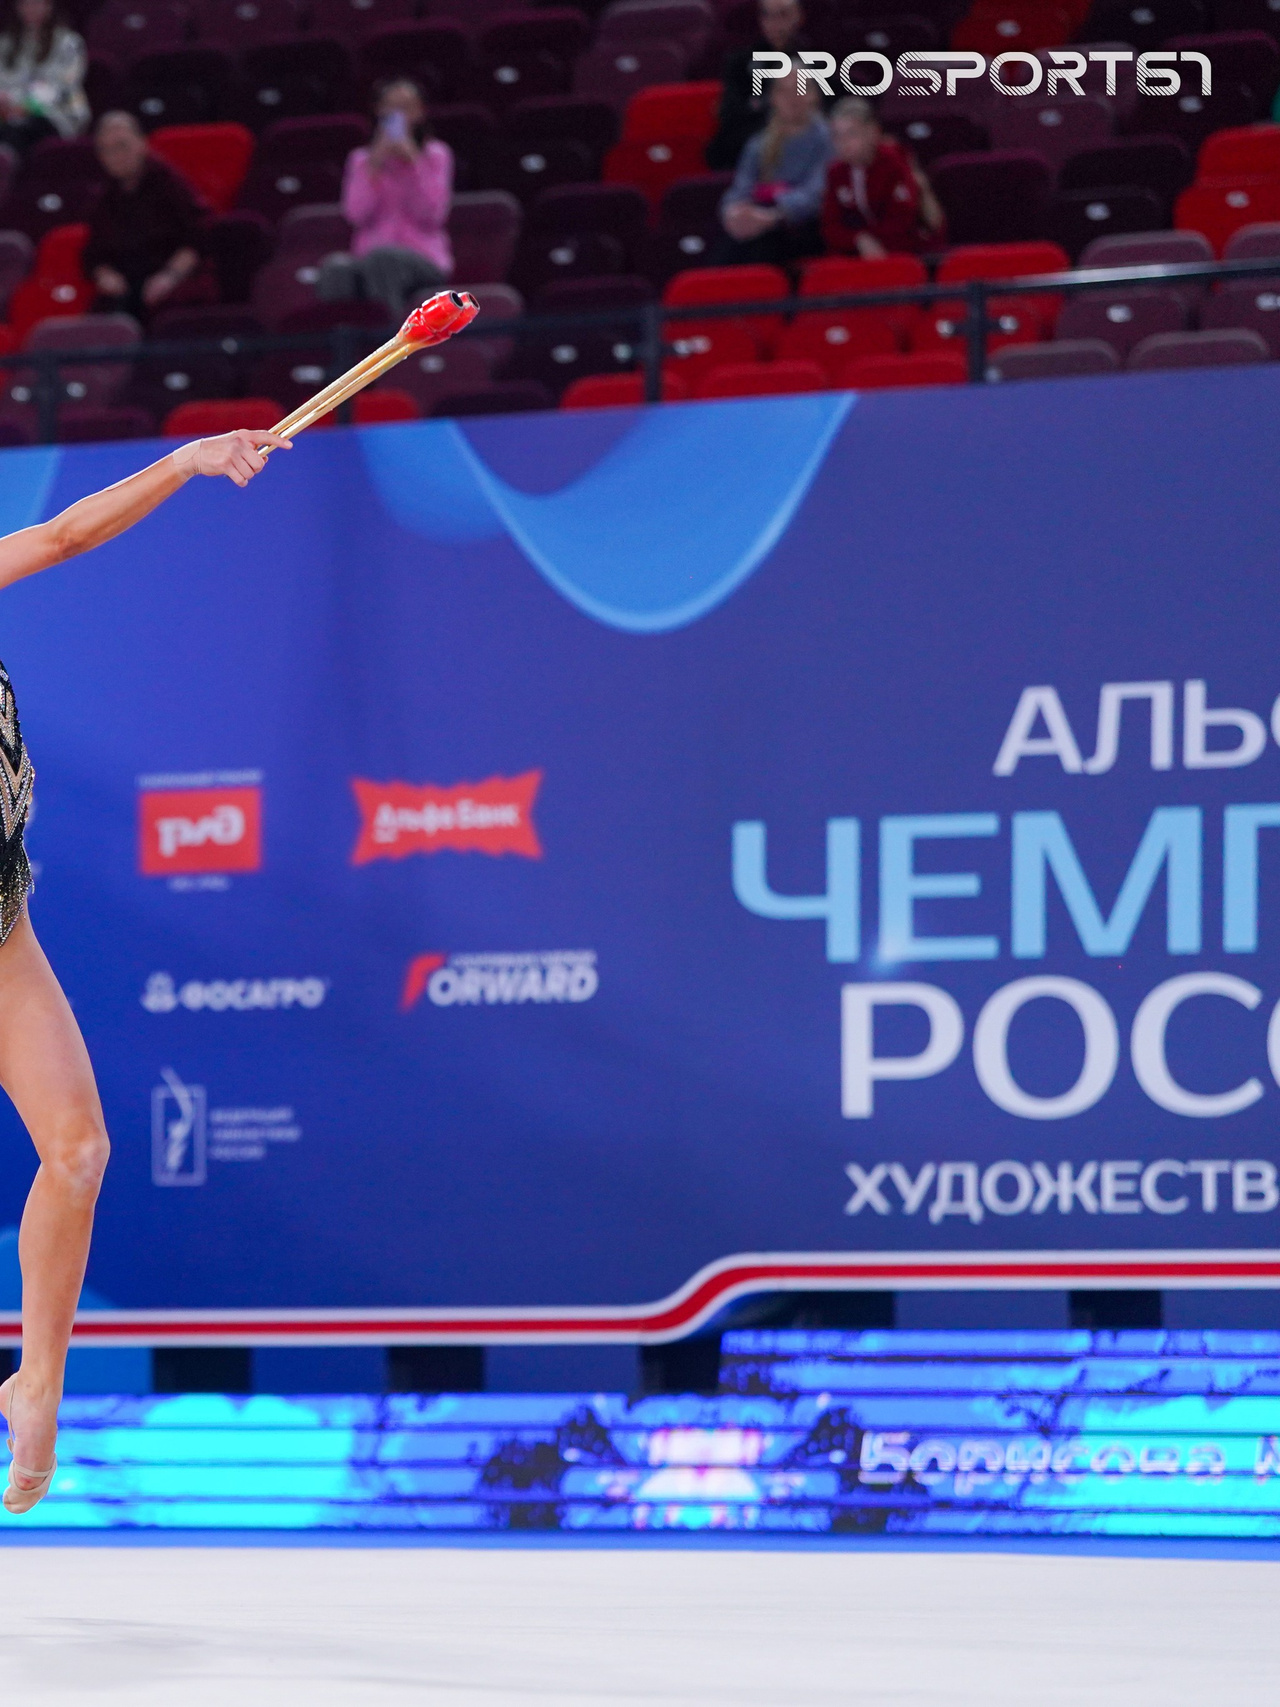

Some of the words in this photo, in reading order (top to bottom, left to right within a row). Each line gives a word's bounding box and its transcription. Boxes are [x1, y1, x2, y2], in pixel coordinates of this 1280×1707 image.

[992, 679, 1280, 777] АЛЬ
[841, 971, 1280, 1121] РОС
[844, 1159, 1280, 1225] ХУДОЖЕСТВ
